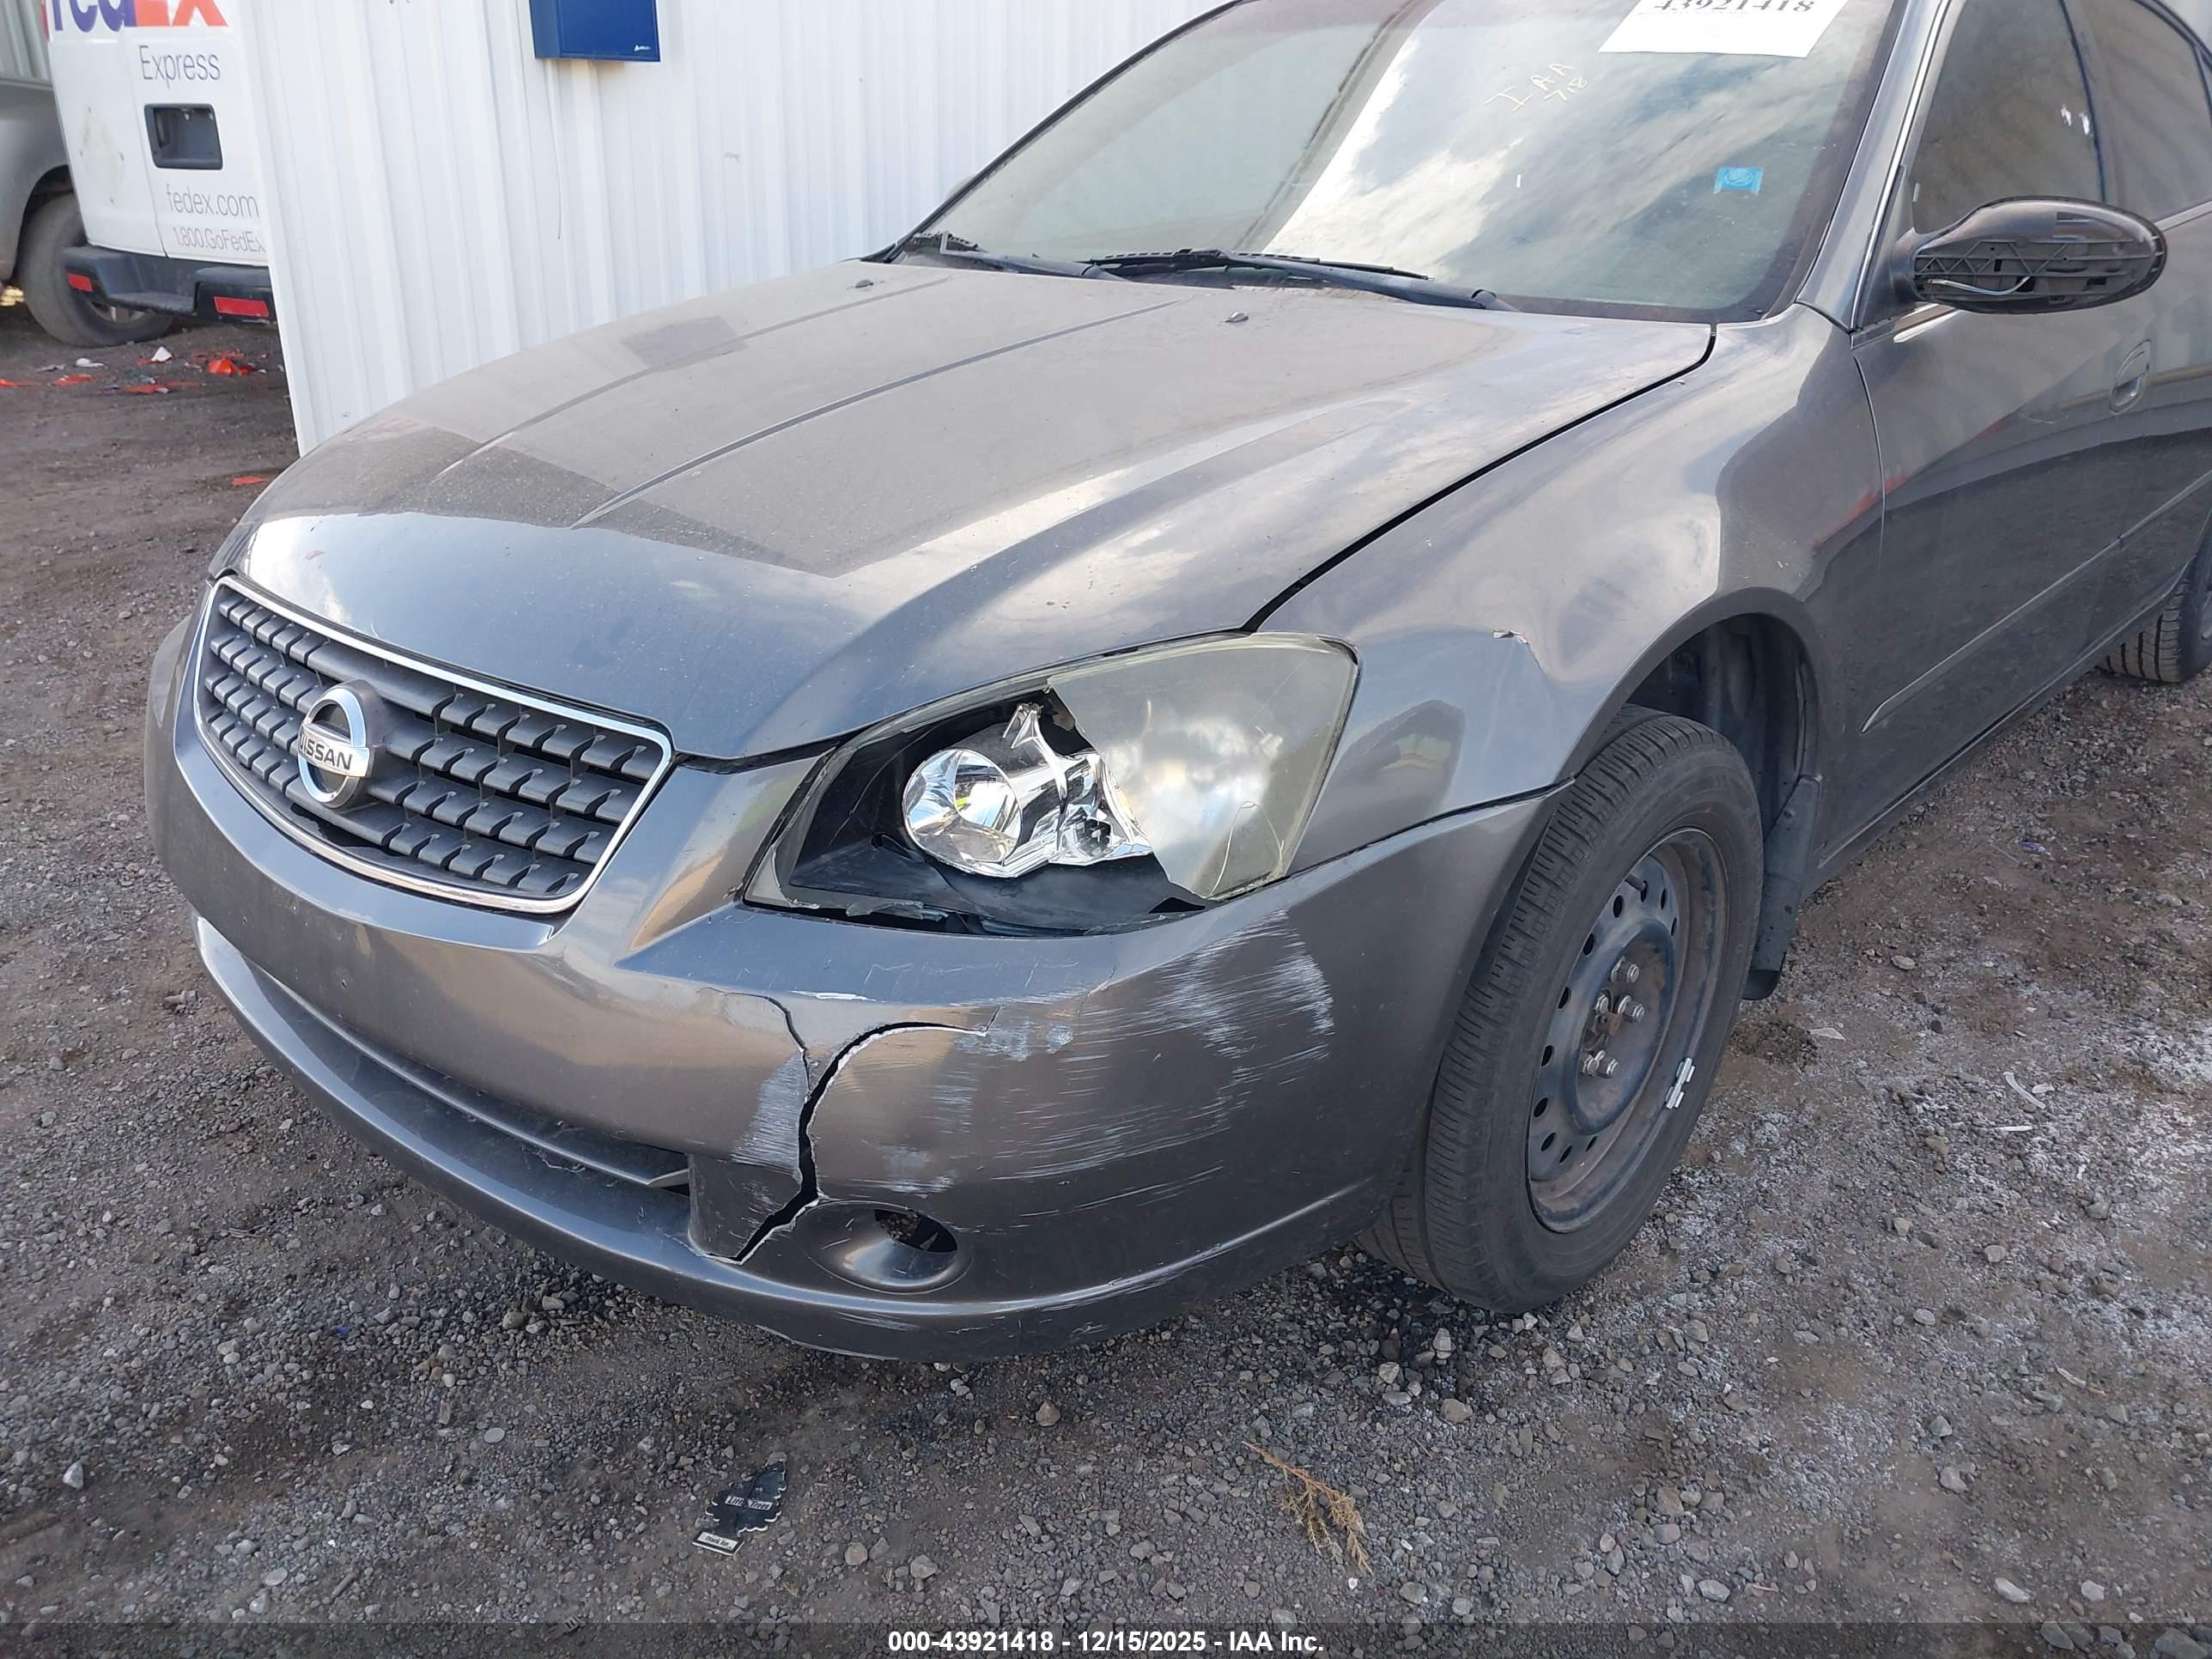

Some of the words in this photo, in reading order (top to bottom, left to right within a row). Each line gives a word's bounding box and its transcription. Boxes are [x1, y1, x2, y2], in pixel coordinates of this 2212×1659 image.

[139, 46, 221, 88] Express
[1484, 63, 1575, 112] IAA
[166, 184, 260, 218] fedex.com
[300, 733, 353, 770] NISSAN
